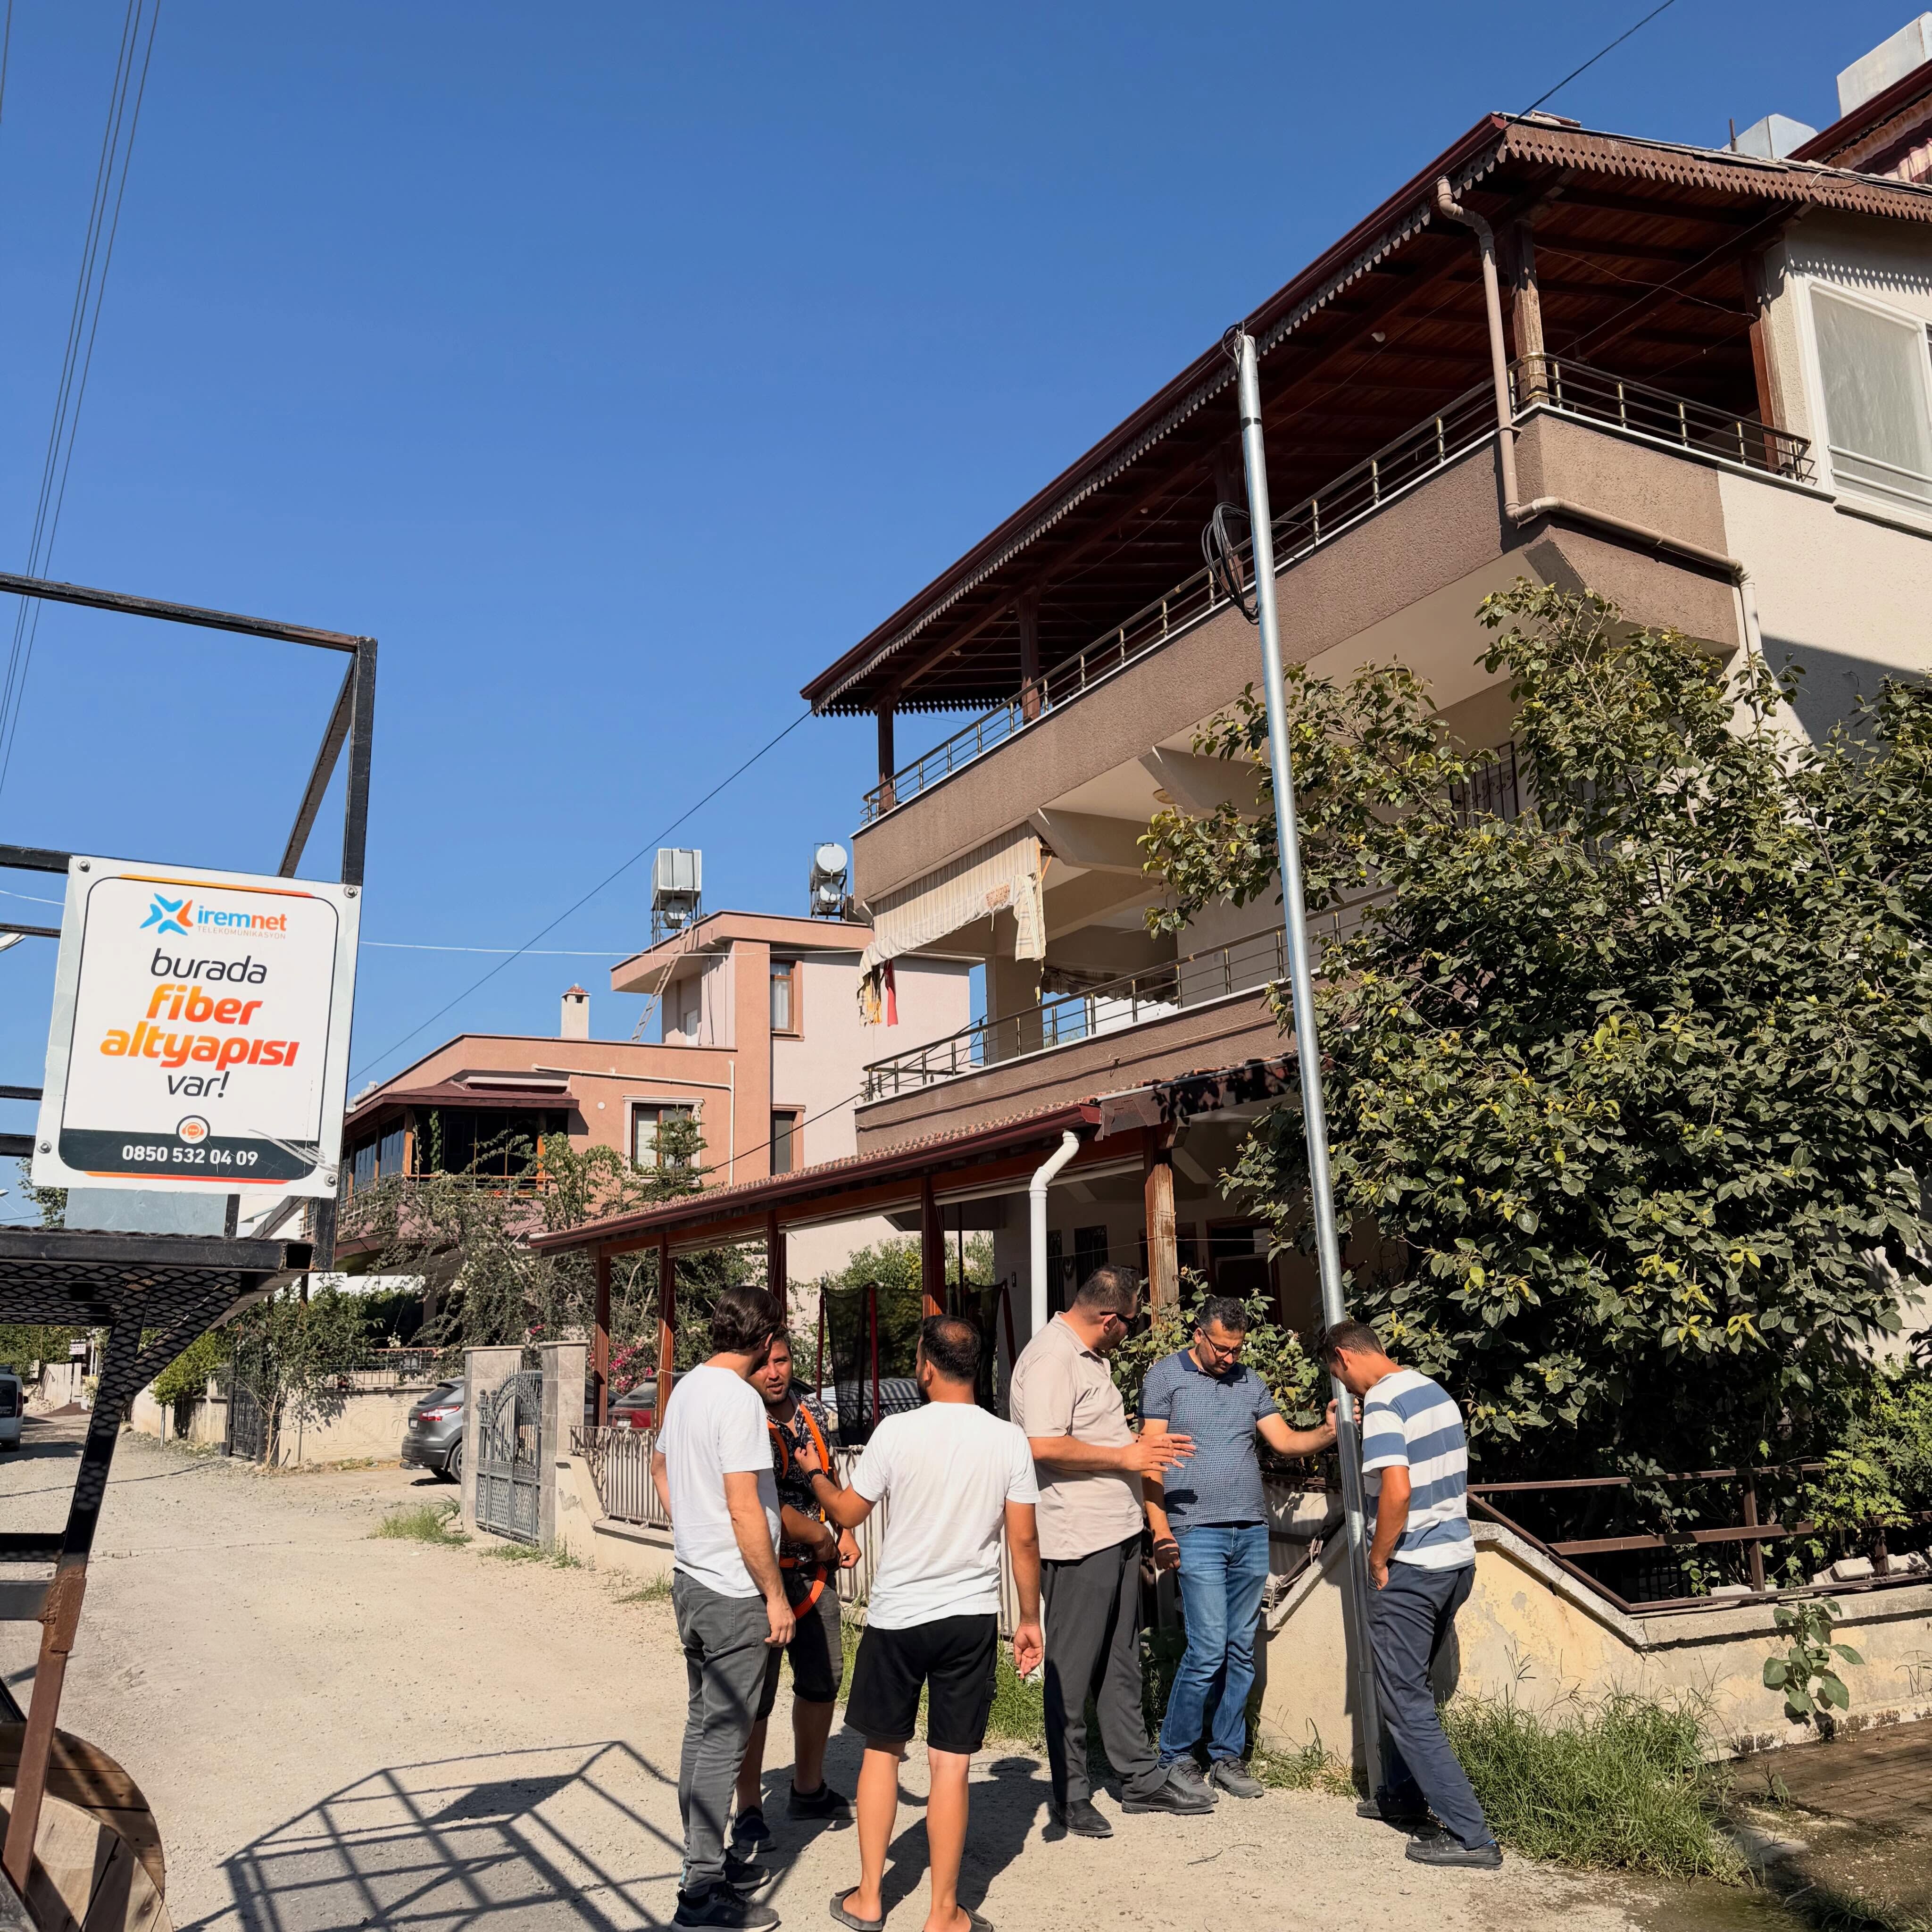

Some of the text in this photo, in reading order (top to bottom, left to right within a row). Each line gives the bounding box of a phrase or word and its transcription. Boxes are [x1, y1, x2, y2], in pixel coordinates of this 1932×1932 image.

[198, 906, 287, 932] iremnet
[151, 948, 267, 984] burada
[146, 983, 264, 1025] fiber
[100, 1021, 300, 1071] altyapısı
[167, 1071, 230, 1098] var!
[122, 1145, 258, 1166] 0850 532 04 09
